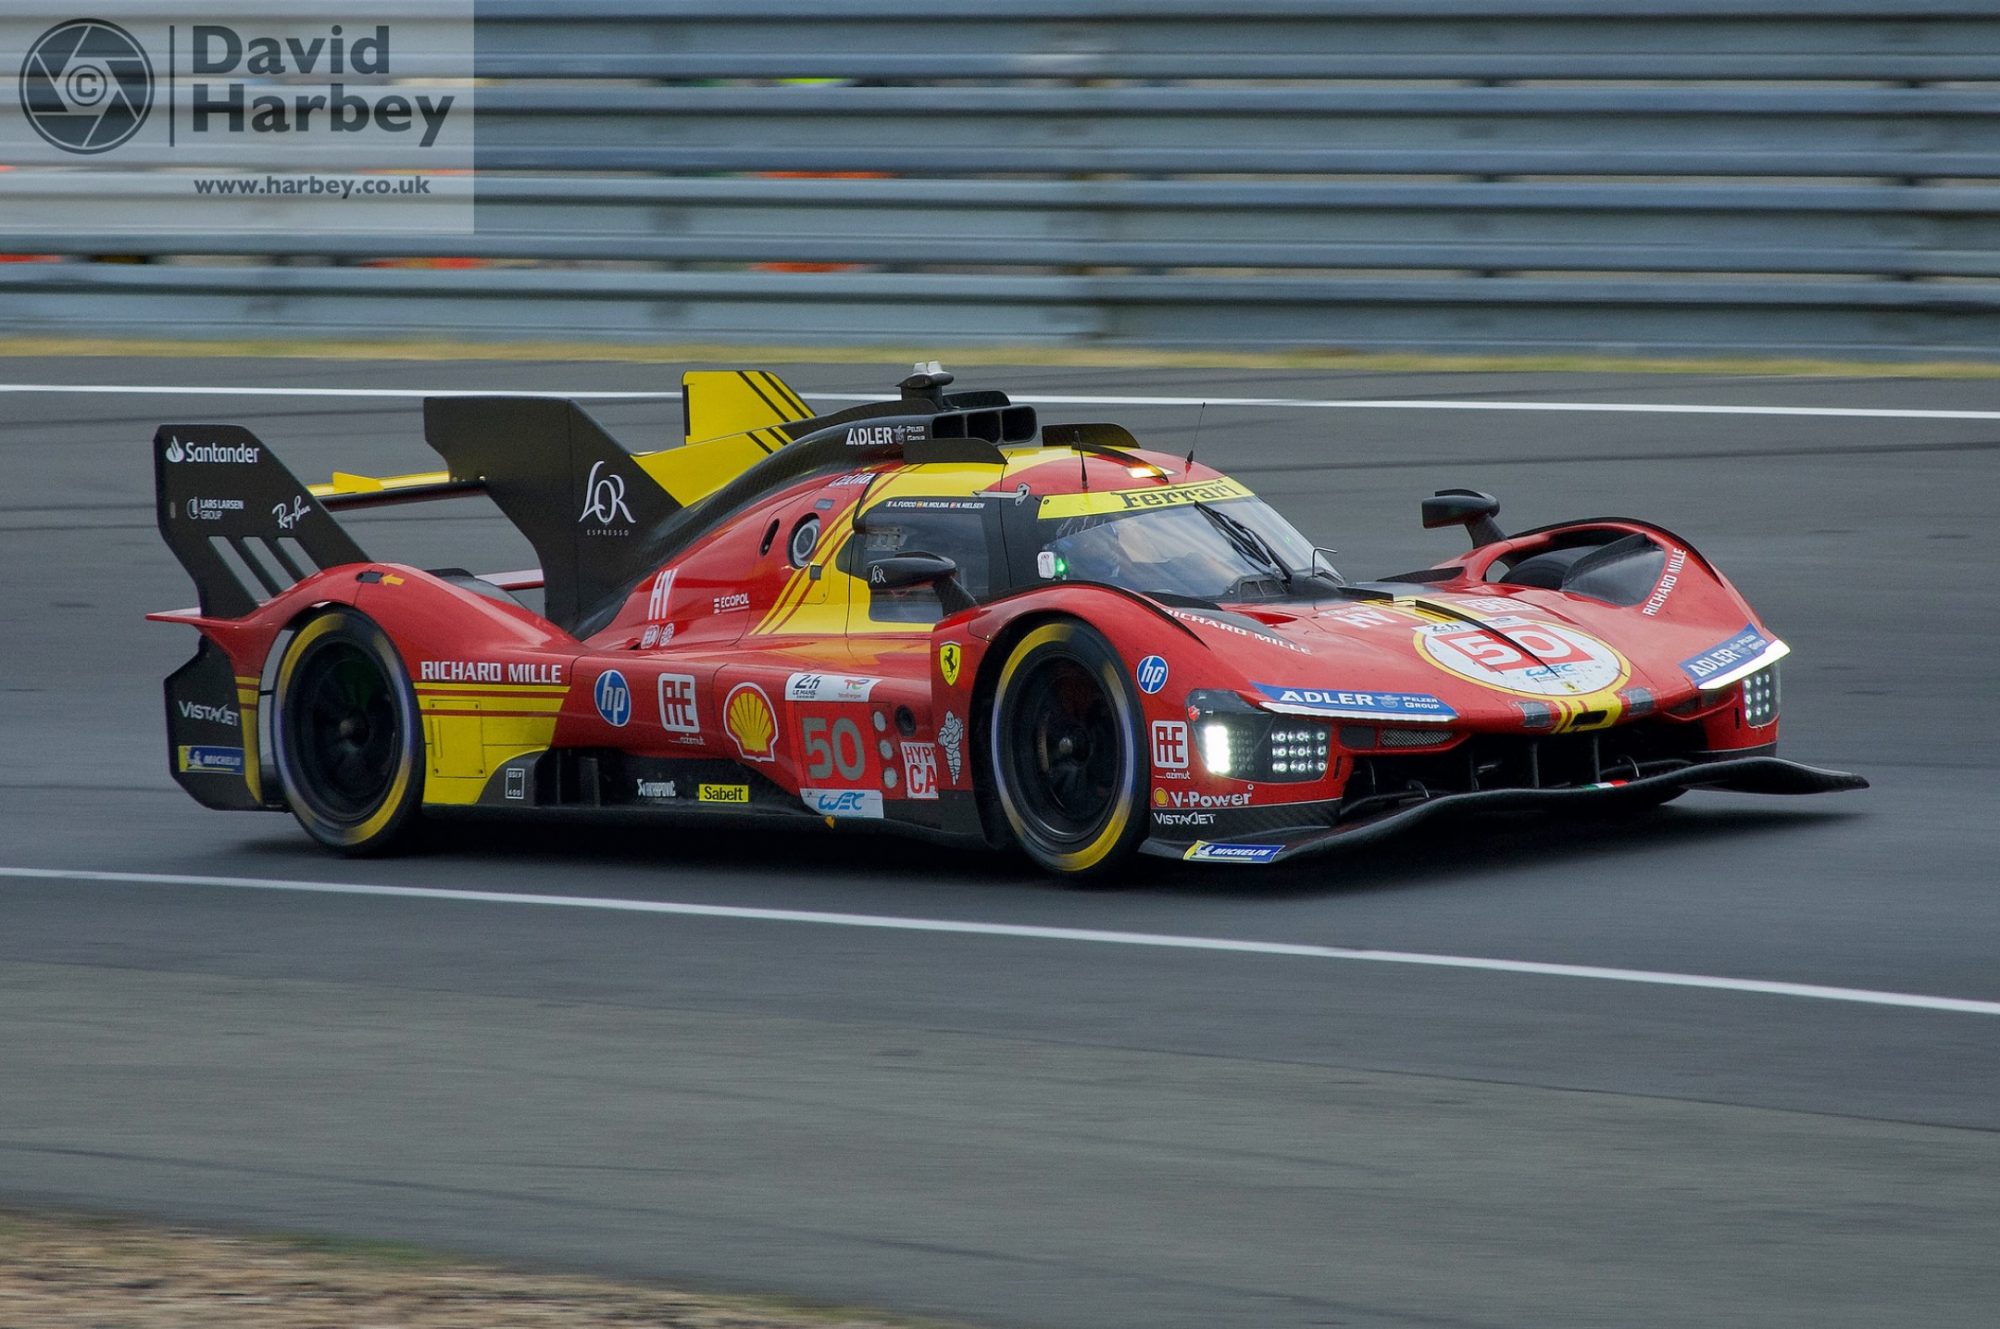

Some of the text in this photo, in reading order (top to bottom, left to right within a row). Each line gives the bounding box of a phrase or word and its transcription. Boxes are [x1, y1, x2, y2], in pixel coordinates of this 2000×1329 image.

[846, 427, 893, 445] ADLER
[186, 442, 259, 463] Santander
[1111, 480, 1240, 508] Ferrari
[1642, 547, 1687, 616] RICHARD MILLE
[721, 593, 750, 608] ECOPOL
[1254, 633, 1312, 655] MILLE
[1448, 630, 1572, 666] 50
[420, 661, 562, 683] RICHARD MILLE
[1688, 648, 1742, 677] ADLER
[1141, 656, 1166, 693] hp
[600, 673, 627, 725] hp
[1280, 690, 1376, 706] ADLER
[803, 717, 866, 781] 50
[704, 786, 743, 800] Sabelt
[1170, 790, 1252, 808] V-Power
[1212, 847, 1271, 856] MICHELIN
